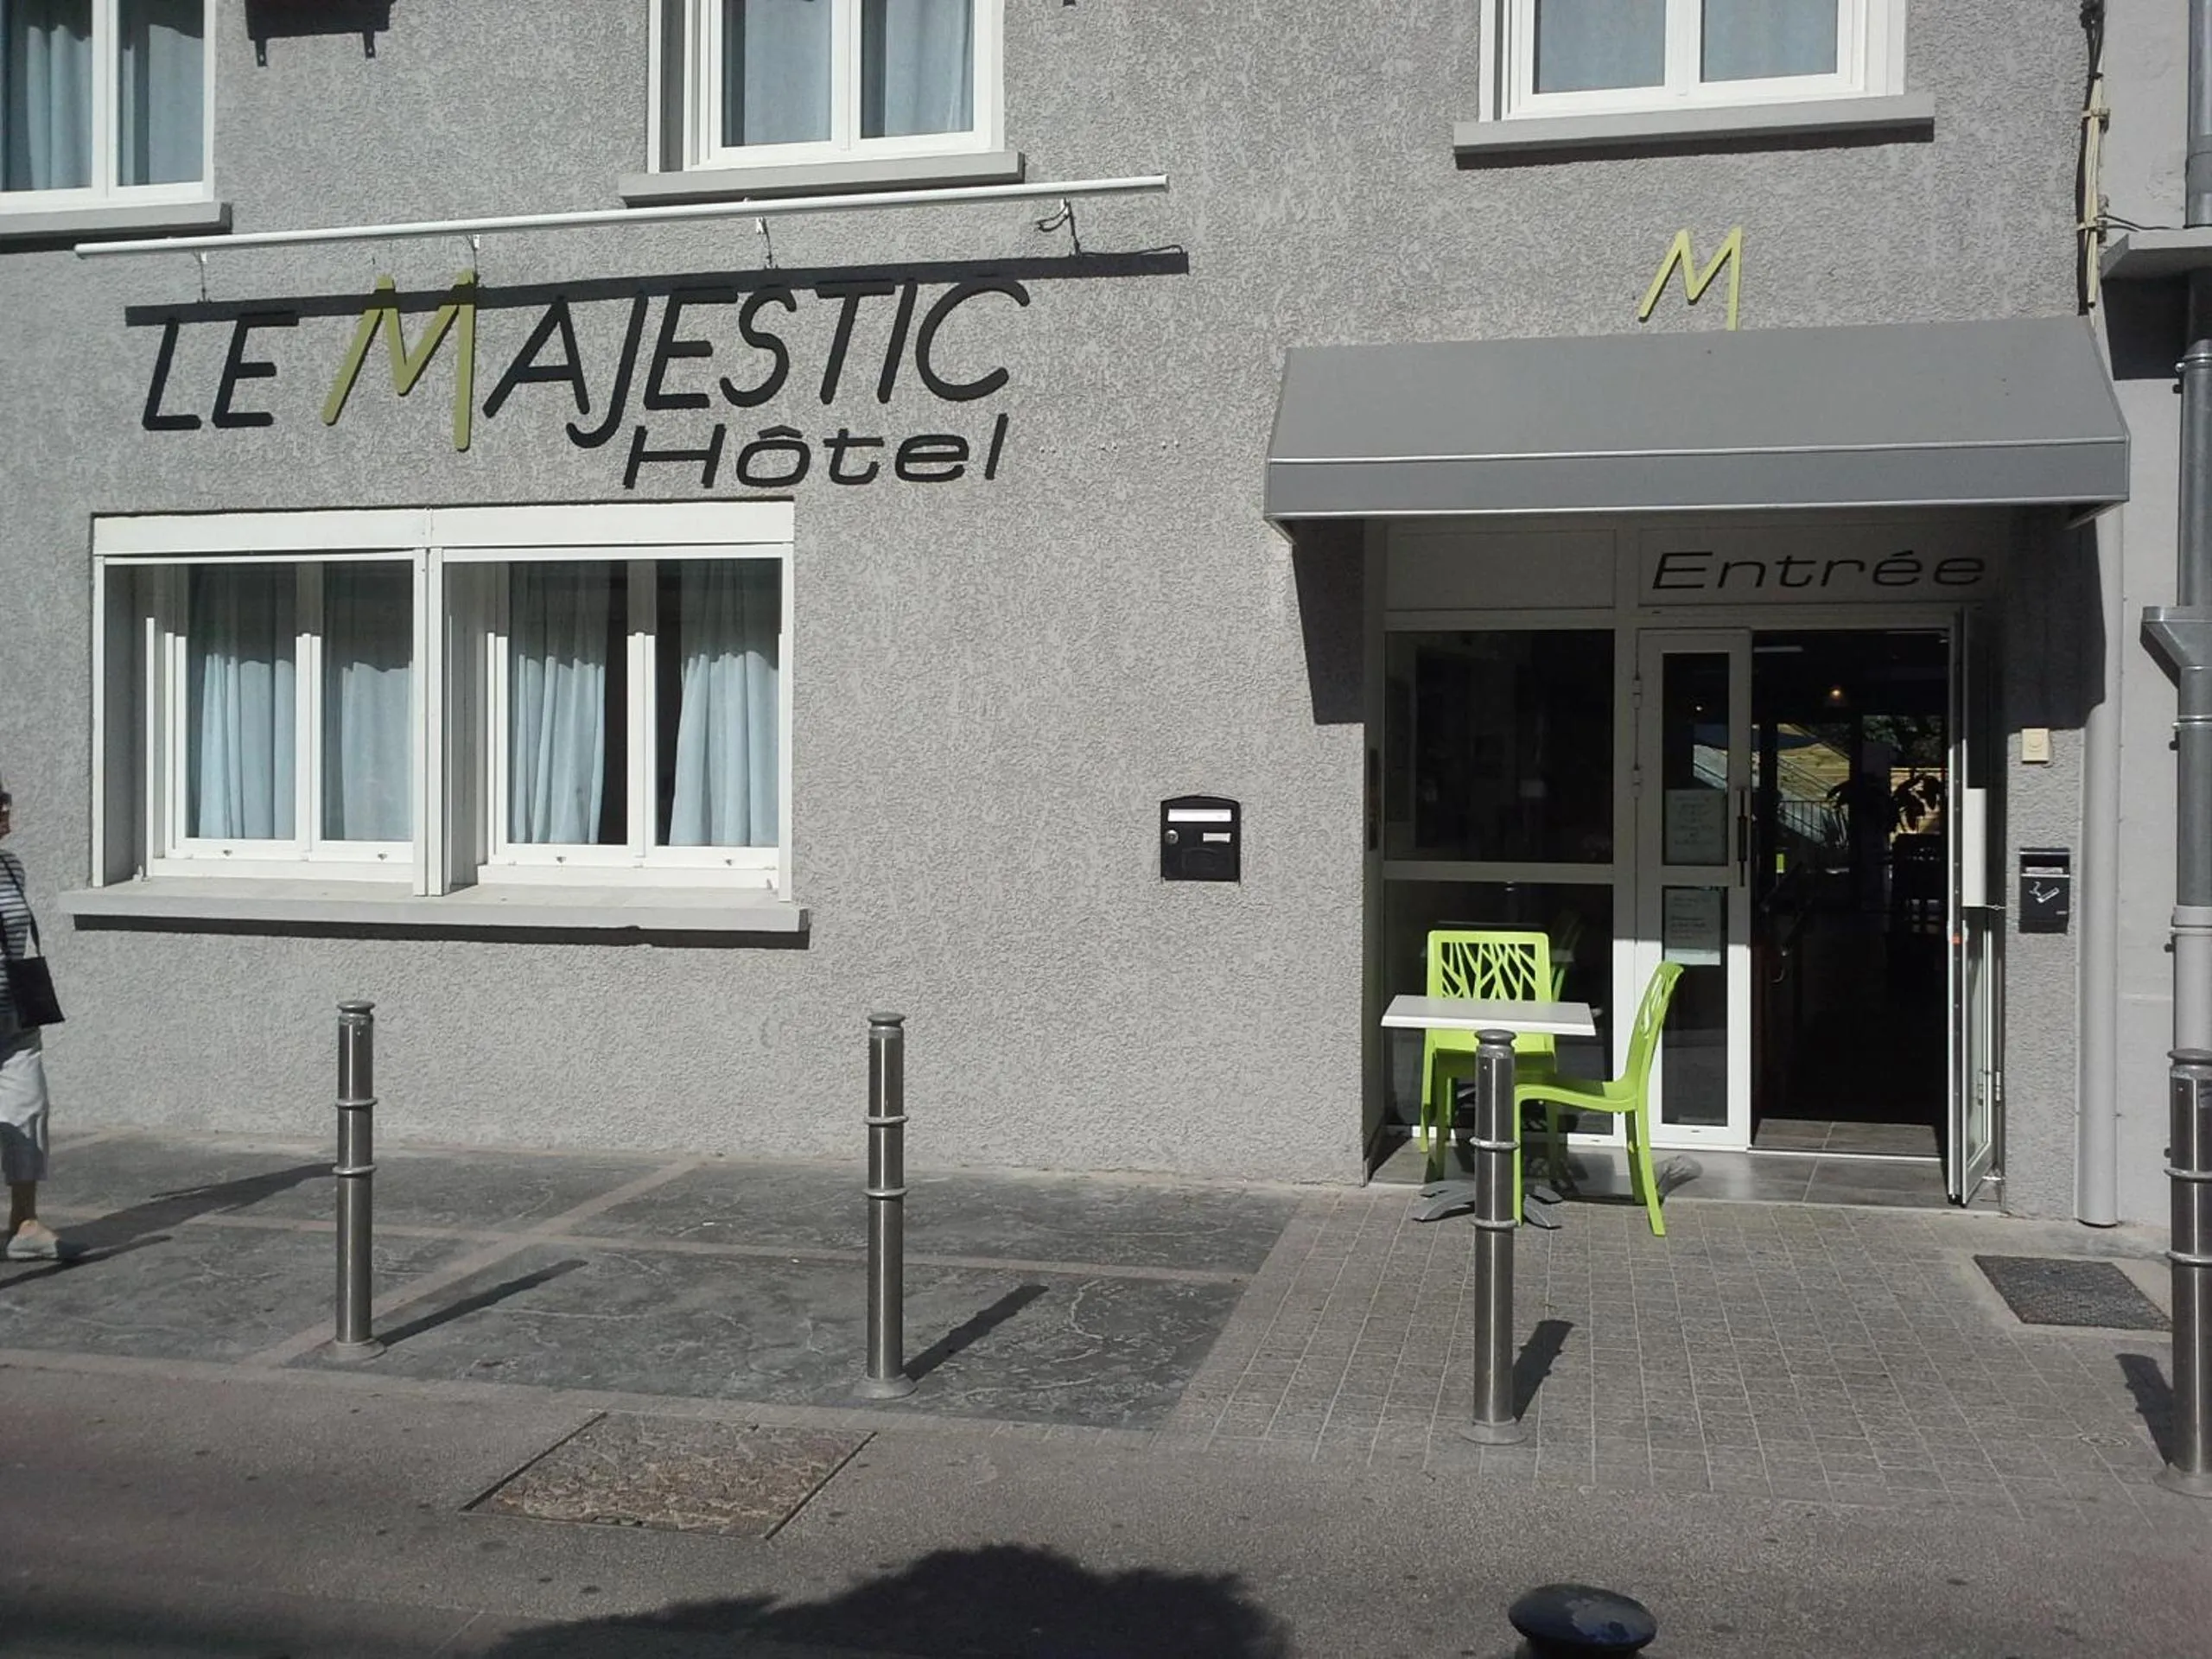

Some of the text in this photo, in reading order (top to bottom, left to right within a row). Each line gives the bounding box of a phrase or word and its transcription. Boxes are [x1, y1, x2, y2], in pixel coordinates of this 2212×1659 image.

[1637, 226, 1742, 332] M
[142, 269, 1030, 451] LE MAJESTIC
[623, 412, 1008, 490] Hôtel
[1652, 550, 1986, 590] Entrée
